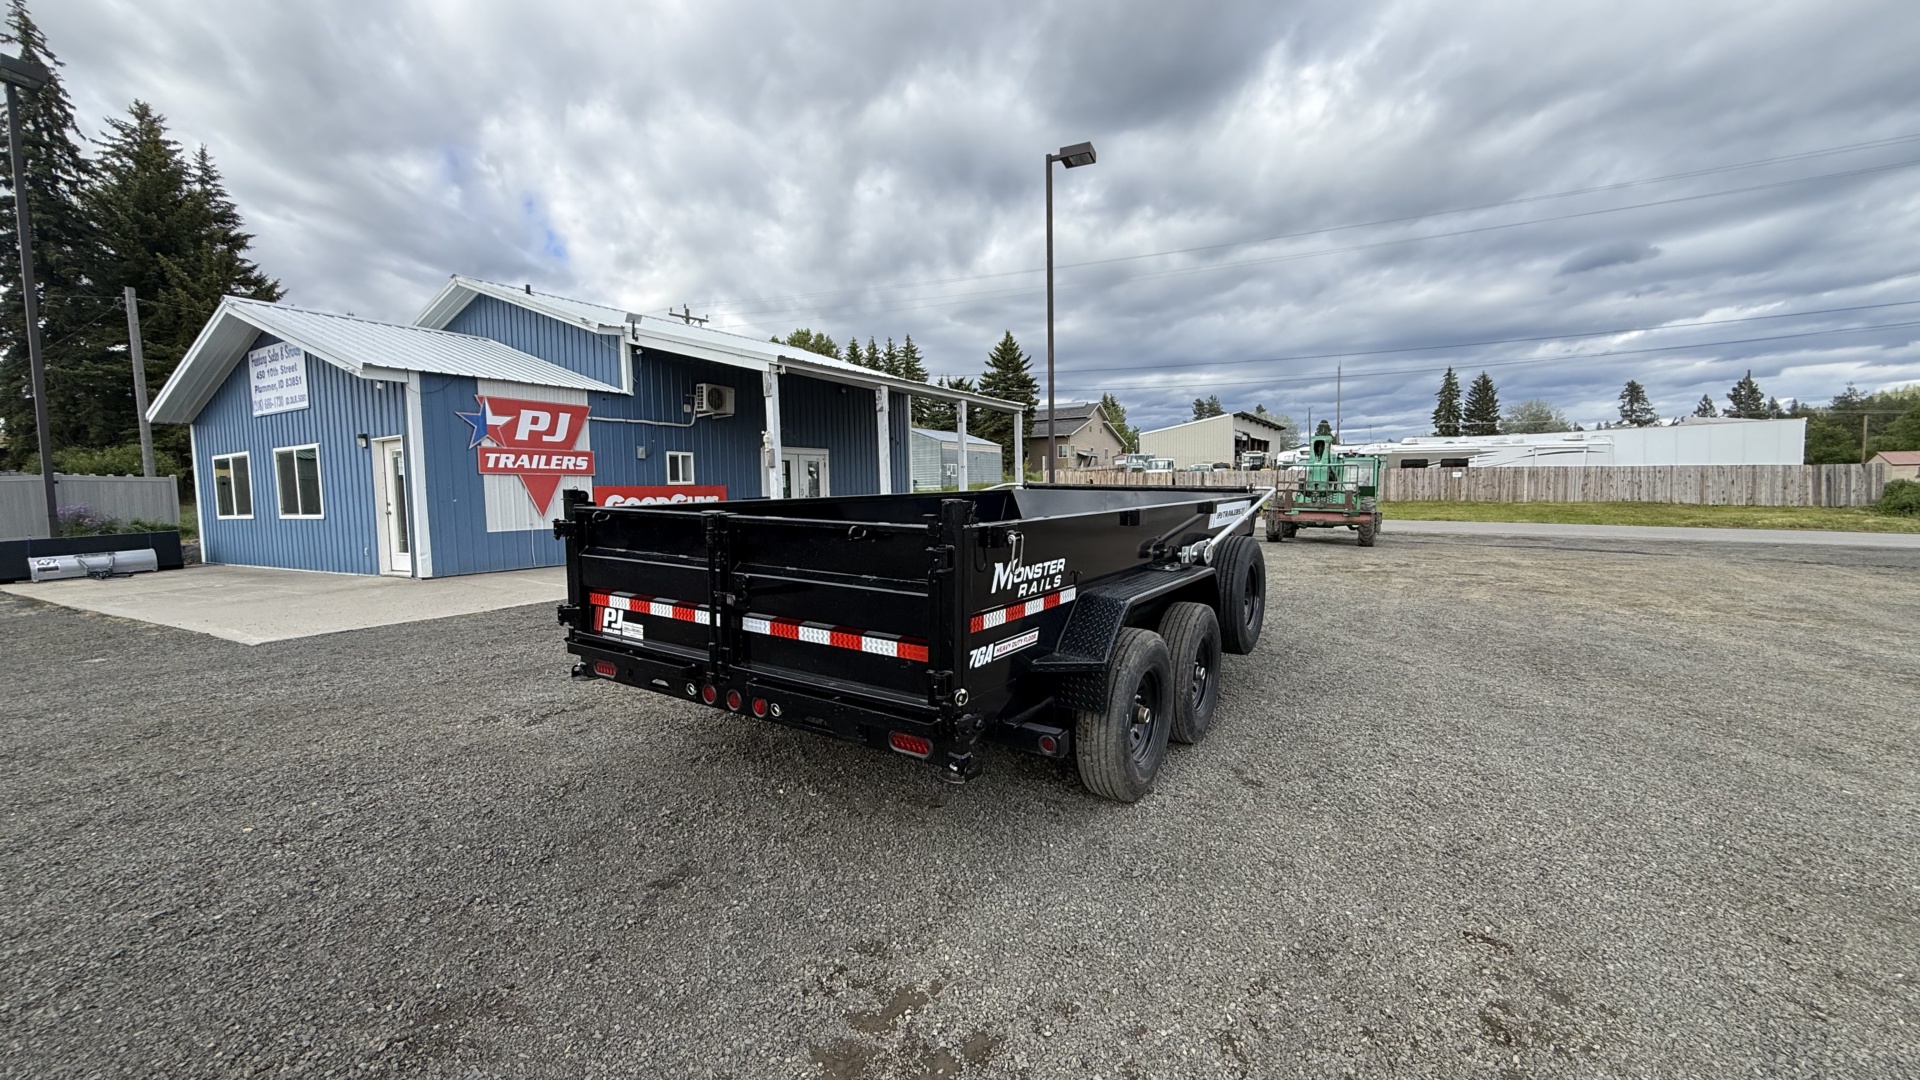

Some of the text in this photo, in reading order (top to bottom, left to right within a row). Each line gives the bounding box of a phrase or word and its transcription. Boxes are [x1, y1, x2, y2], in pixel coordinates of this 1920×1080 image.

[267, 367, 279, 379] 10th
[280, 363, 297, 374] Street
[515, 409, 572, 442] PJ
[485, 453, 588, 470] TRAILERS
[991, 558, 1066, 594] MONSTER
[1018, 575, 1062, 597] RAILS
[603, 608, 624, 629] PJ
[969, 633, 1037, 669] 7GA HEAVY DUTY FLOOR
